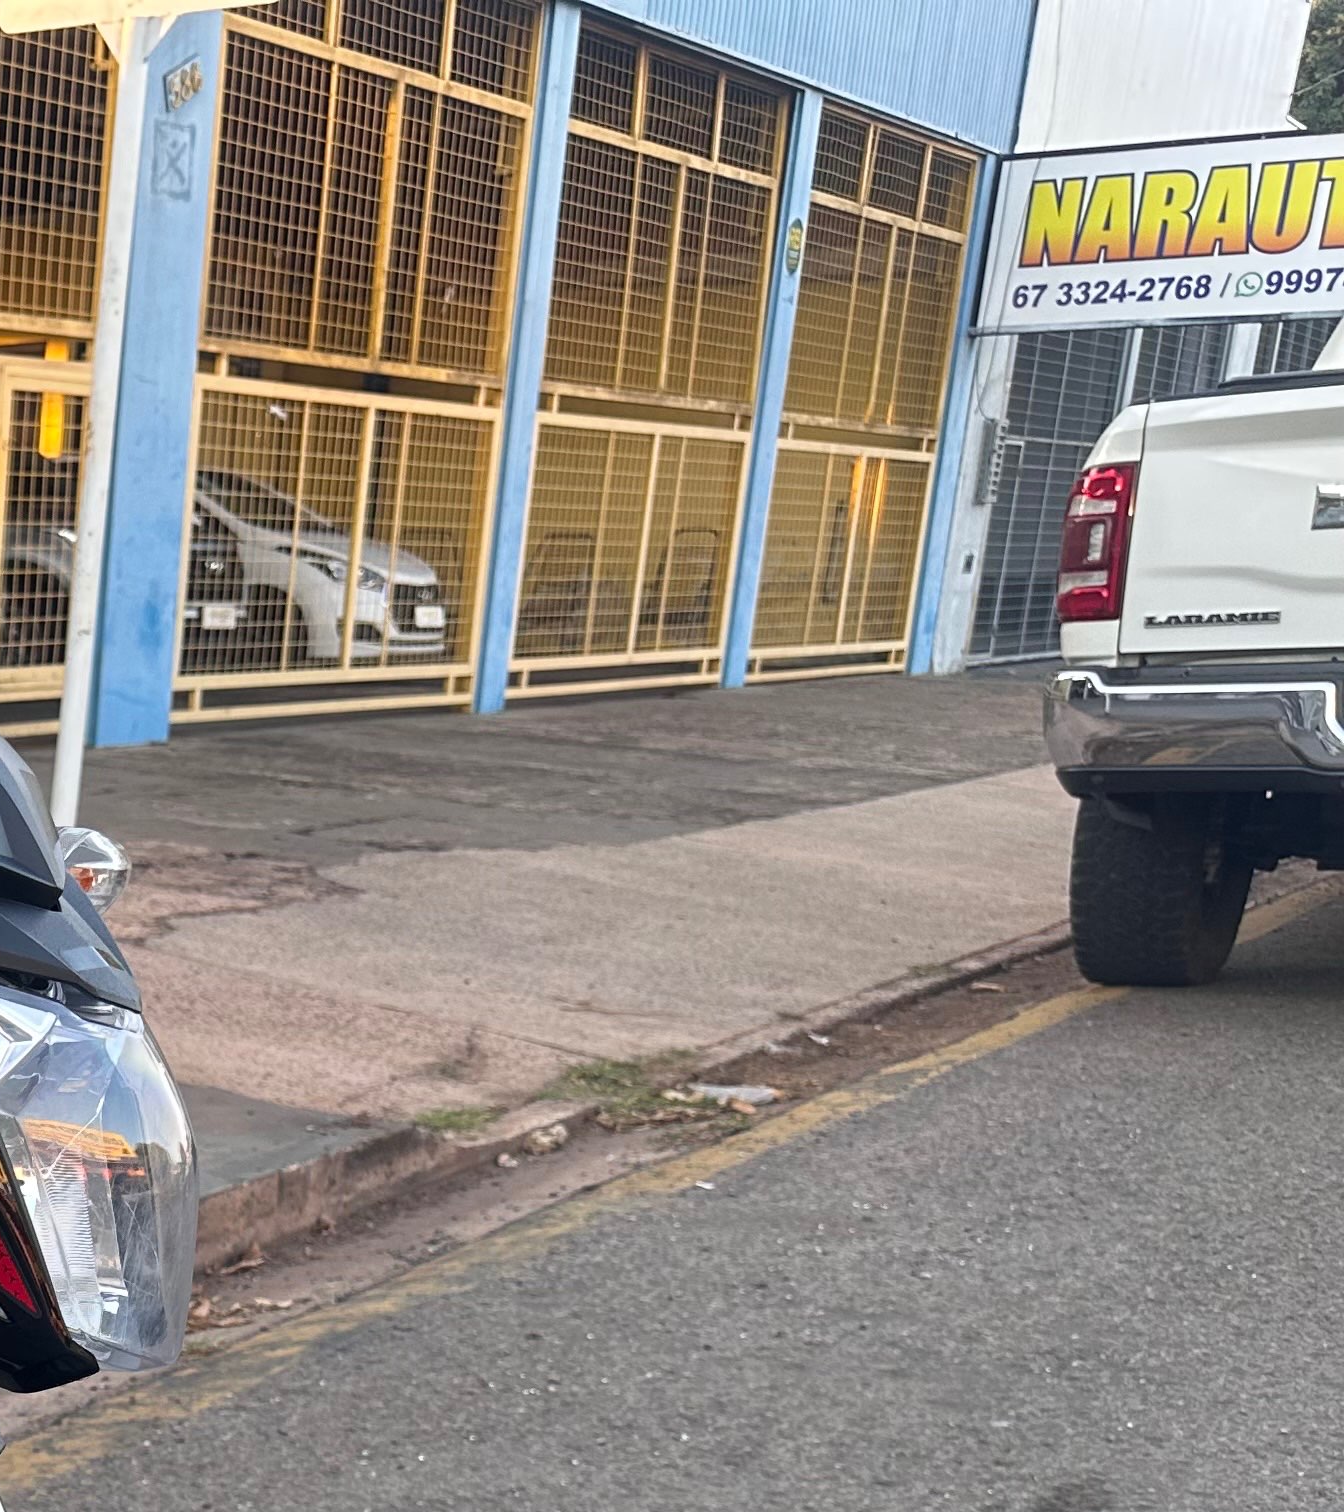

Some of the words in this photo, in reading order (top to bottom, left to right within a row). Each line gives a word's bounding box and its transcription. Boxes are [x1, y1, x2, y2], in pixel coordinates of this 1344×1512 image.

[1012, 284, 1047, 309] 67
[1056, 274, 1212, 307] 3324-2768
[1264, 266, 1344, 296] 9997
[1144, 610, 1281, 629] LARAMIE
